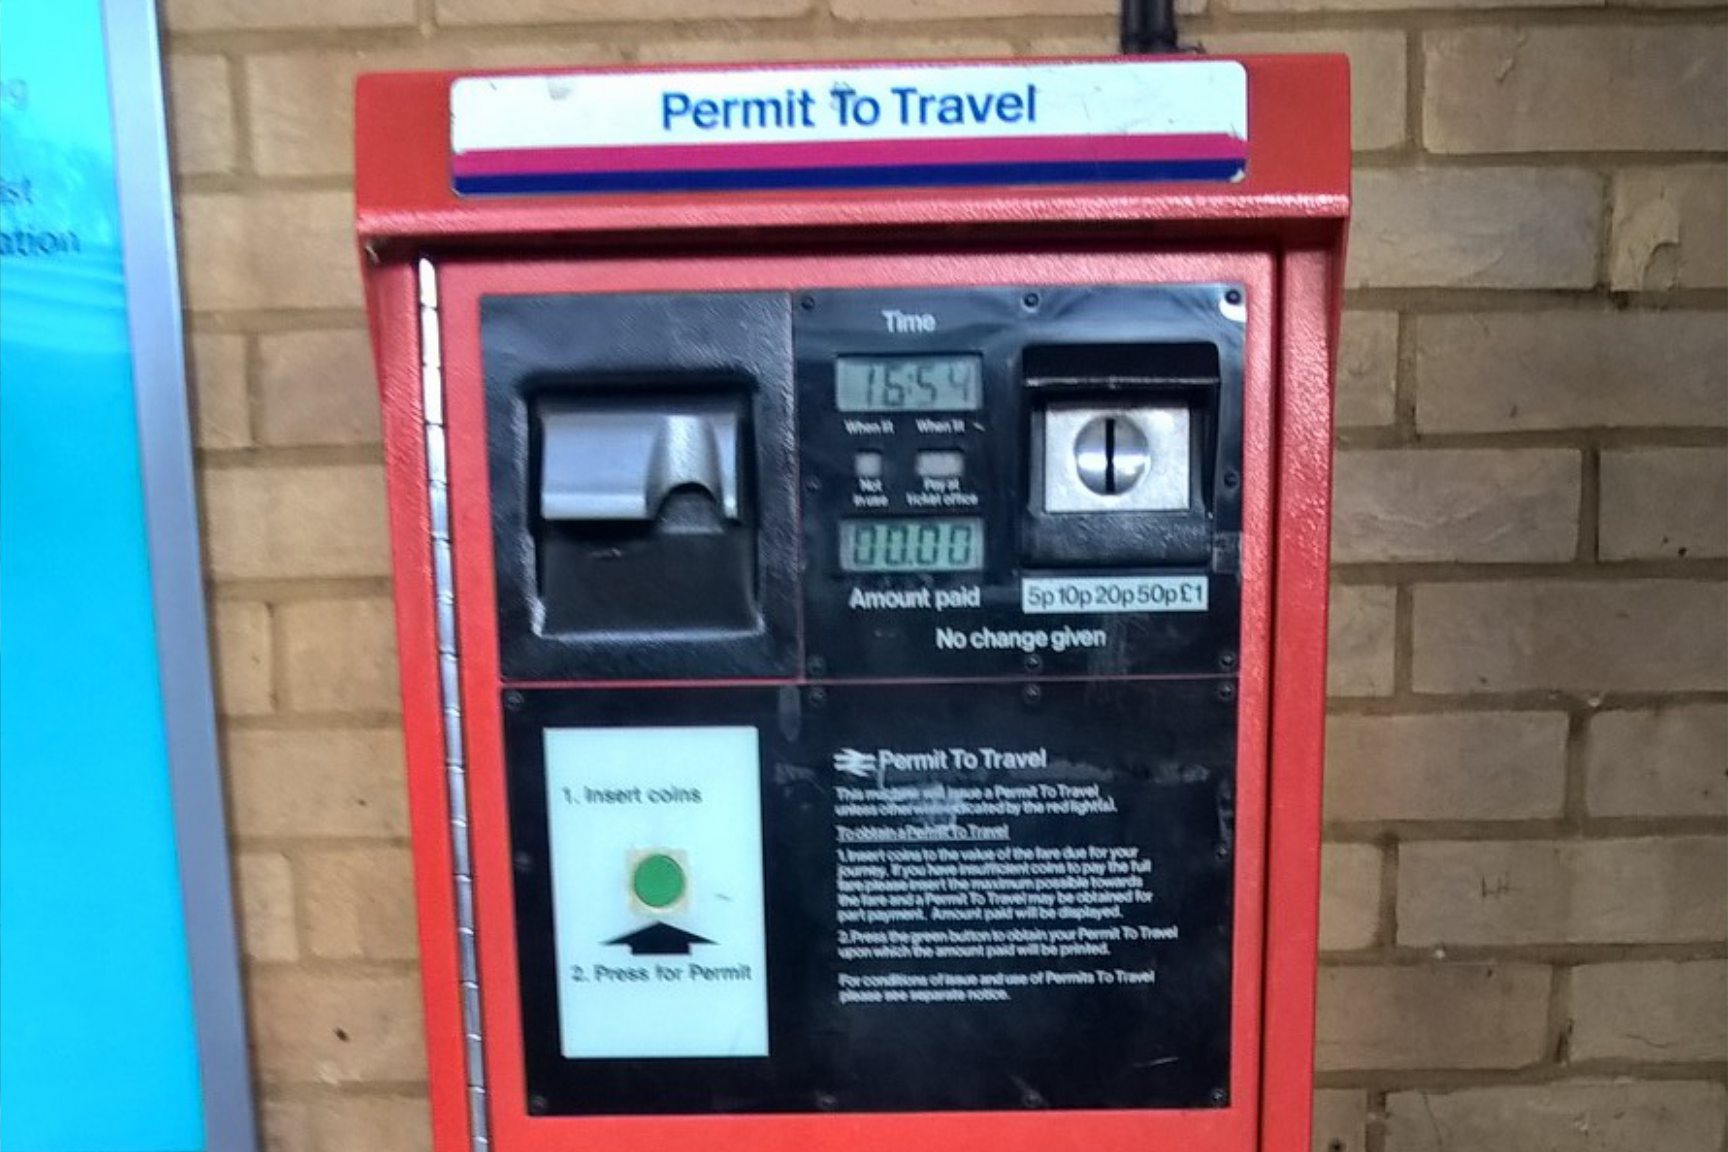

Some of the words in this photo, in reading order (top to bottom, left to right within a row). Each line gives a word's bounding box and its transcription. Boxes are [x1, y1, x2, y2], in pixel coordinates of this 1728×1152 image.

[660, 88, 816, 131] Permit
[830, 86, 881, 127] To
[890, 83, 1037, 126] Travel
[881, 308, 937, 333] Time
[867, 360, 970, 407] 16:54
[849, 586, 931, 611] Amount
[935, 585, 981, 613] paid
[1028, 585, 1054, 610] 5p
[1058, 584, 1093, 609] 10p
[1095, 584, 1135, 608] 20p
[1136, 583, 1179, 607] 50p
[1180, 582, 1203, 603] £1
[936, 628, 966, 649] No
[970, 627, 1049, 651] change
[1050, 624, 1107, 651] given
[878, 749, 949, 770] Permit
[949, 748, 979, 769] To
[980, 747, 1047, 769] Travel
[562, 787, 578, 804] 1.
[584, 786, 642, 804] Insert
[649, 785, 703, 804] coins
[994, 784, 1039, 799] Permit
[1039, 784, 1057, 799] To
[1057, 783, 1099, 798] Travel
[1077, 927, 1120, 941] Permit
[1121, 927, 1138, 941] To
[1138, 926, 1178, 940] Travel
[571, 965, 590, 982] 2.
[594, 964, 650, 982] Press
[656, 963, 683, 981] for
[689, 962, 752, 981] Permit
[1114, 970, 1155, 984] Travel
